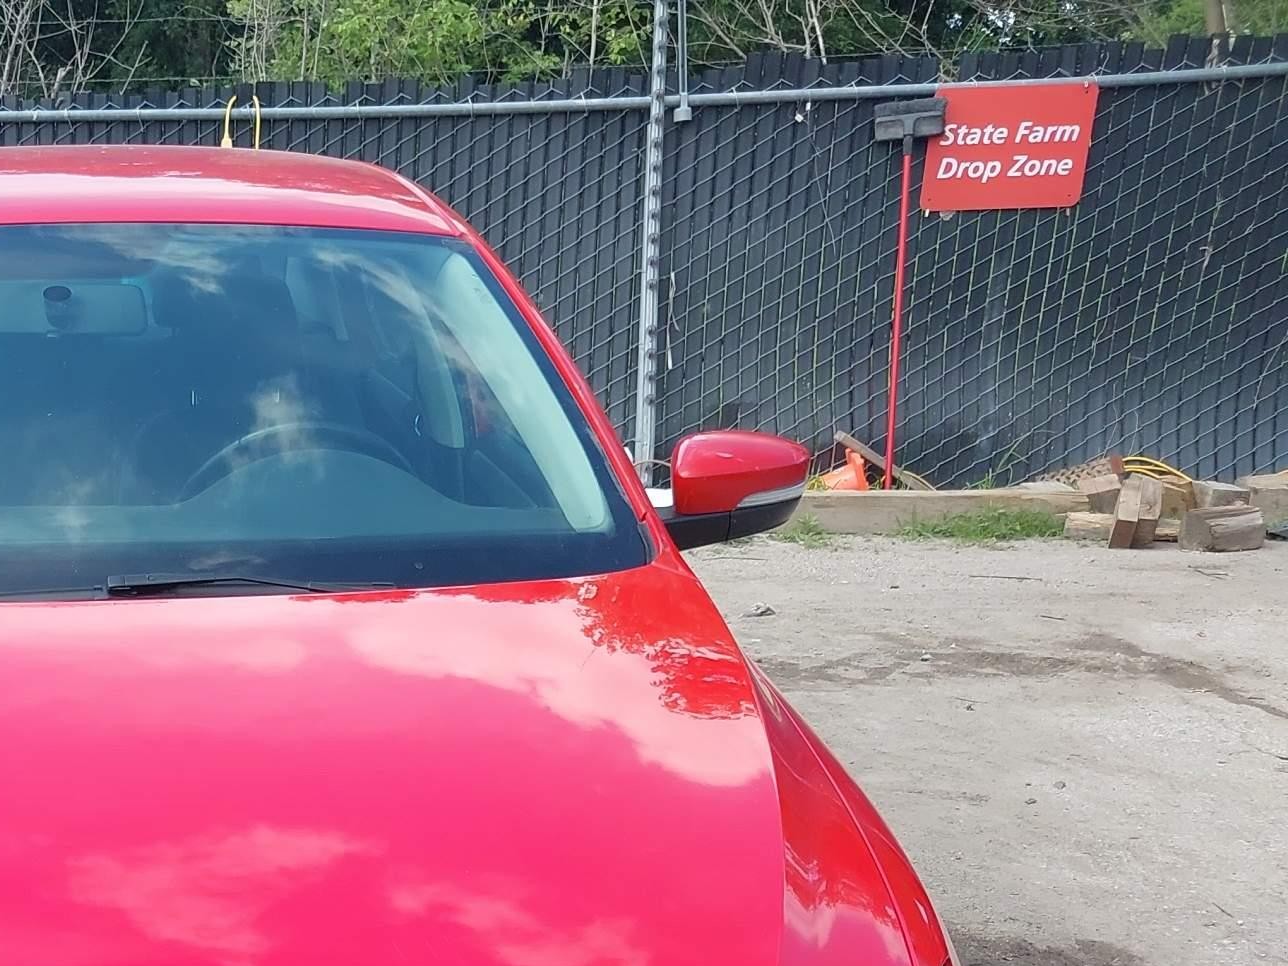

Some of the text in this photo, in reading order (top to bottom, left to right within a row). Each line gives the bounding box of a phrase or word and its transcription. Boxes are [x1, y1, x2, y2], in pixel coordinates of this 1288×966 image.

[939, 121, 1080, 146] State Farm
[937, 155, 1073, 184] Drop Zone
